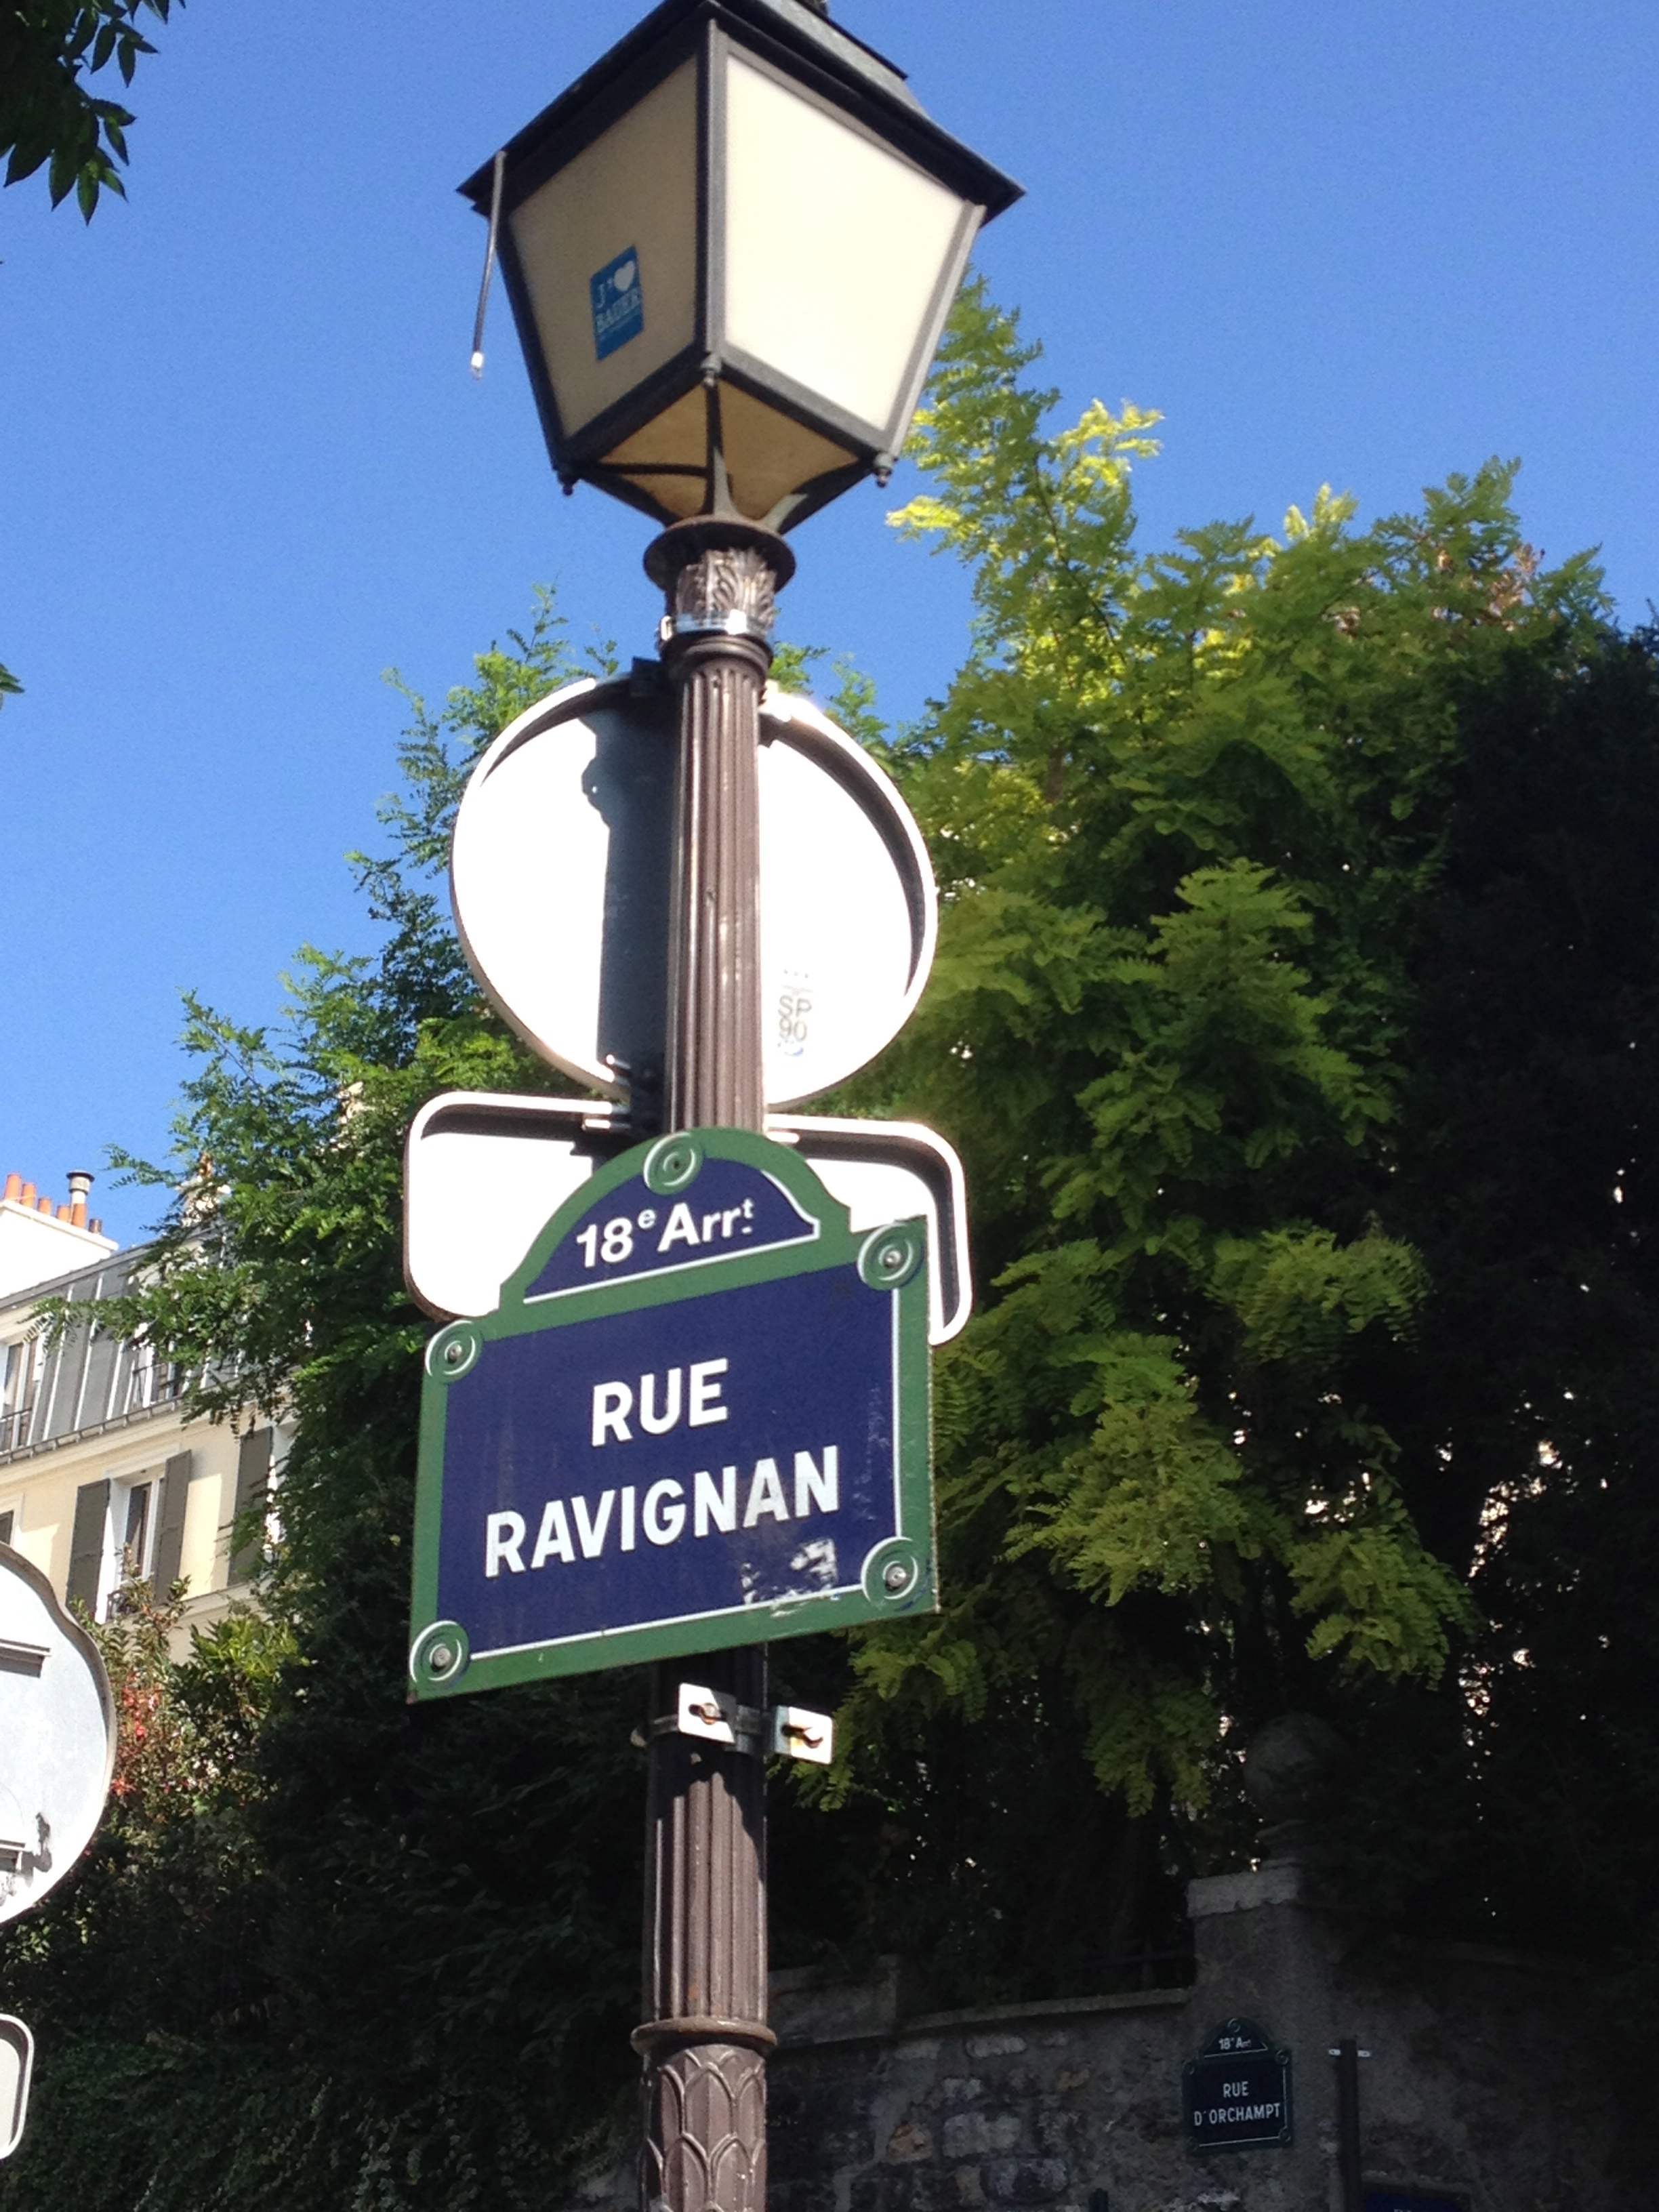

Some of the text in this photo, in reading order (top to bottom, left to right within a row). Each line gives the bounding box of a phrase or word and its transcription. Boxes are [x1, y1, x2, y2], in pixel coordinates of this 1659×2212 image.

[778, 994, 813, 1018] SP
[591, 1357, 730, 1448] RUE
[485, 1445, 840, 1578] RAVIGNAN
[1223, 2081, 1250, 2098] RUE
[1193, 2103, 1280, 2127] D'ORCHAMPT
